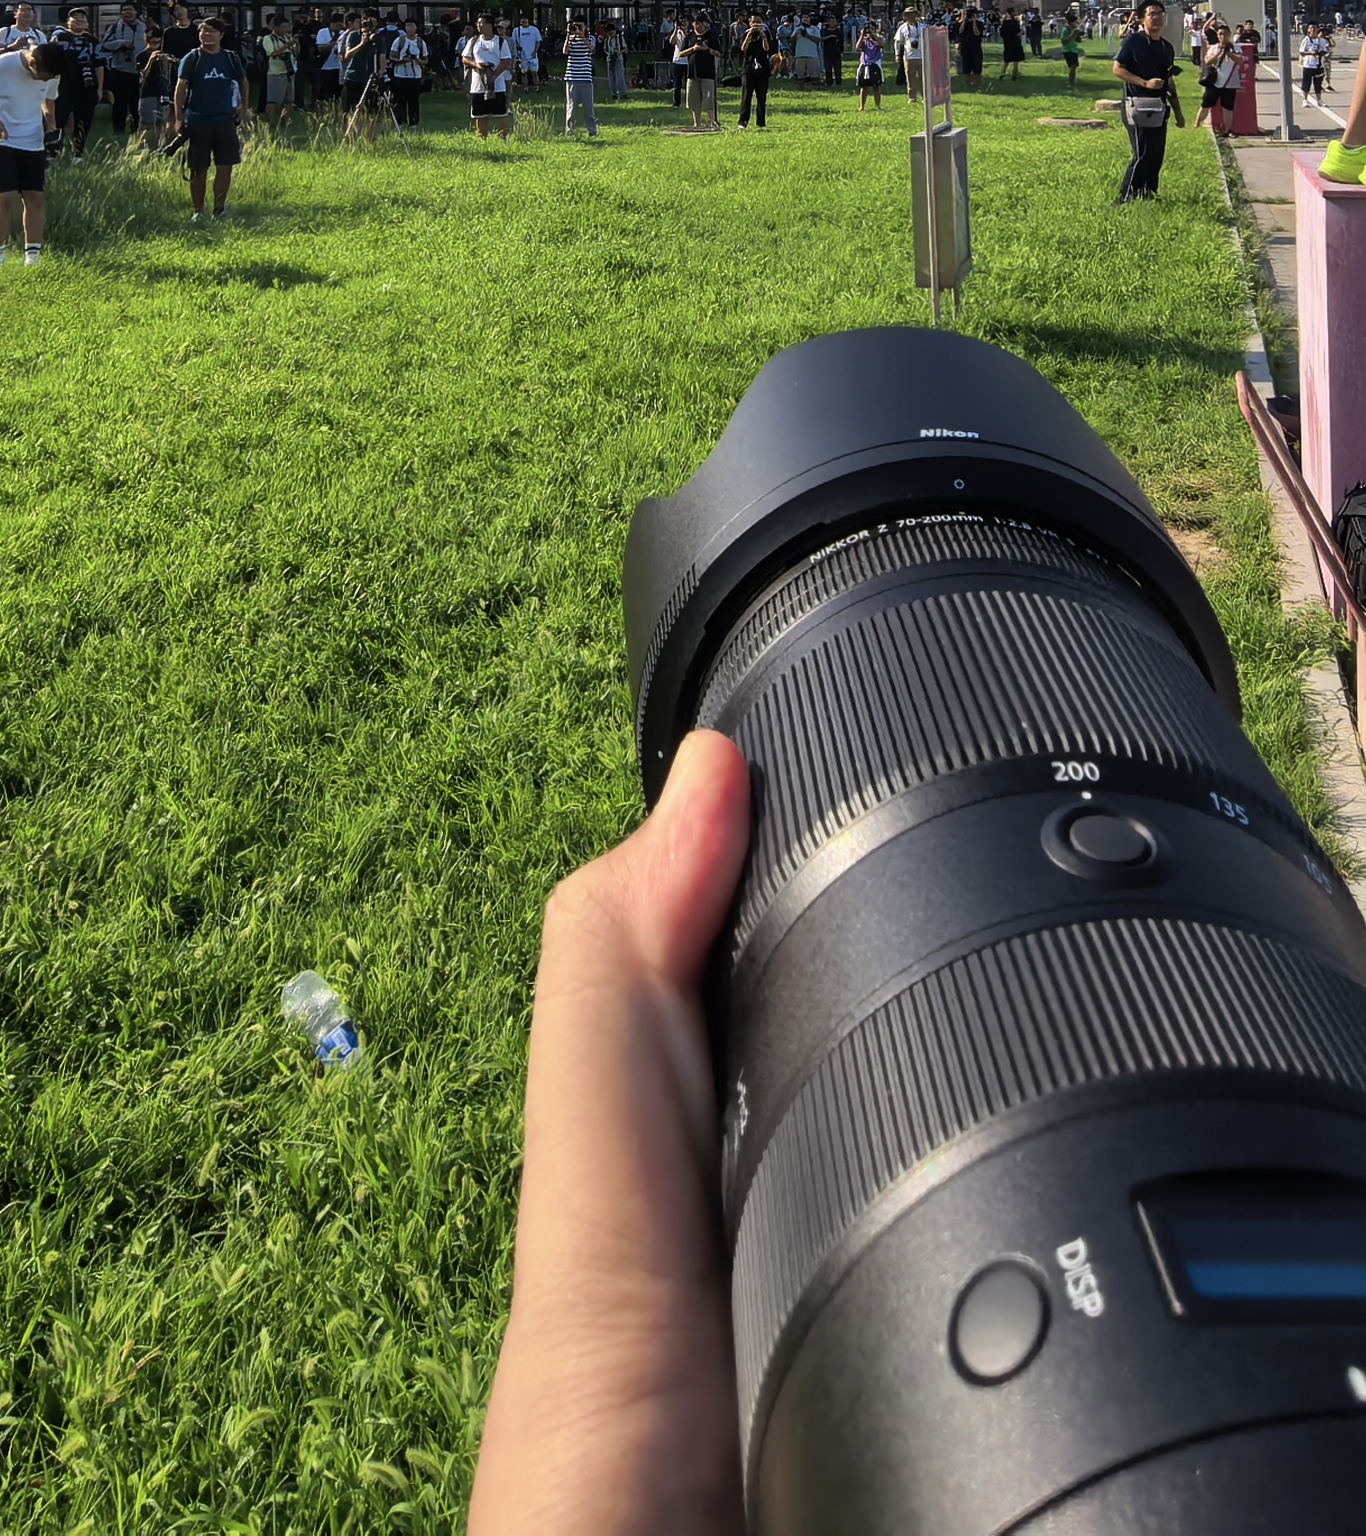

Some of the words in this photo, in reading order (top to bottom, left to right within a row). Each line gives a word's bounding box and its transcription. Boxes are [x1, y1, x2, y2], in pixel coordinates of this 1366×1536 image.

[920, 428, 979, 439] Nikon
[809, 528, 870, 564] NIKKOR
[877, 524, 888, 533] Z
[895, 514, 983, 529] 70-200mm
[1051, 761, 1100, 782] 200
[1209, 791, 1249, 825] 135
[1056, 1236, 1104, 1317] DISP
